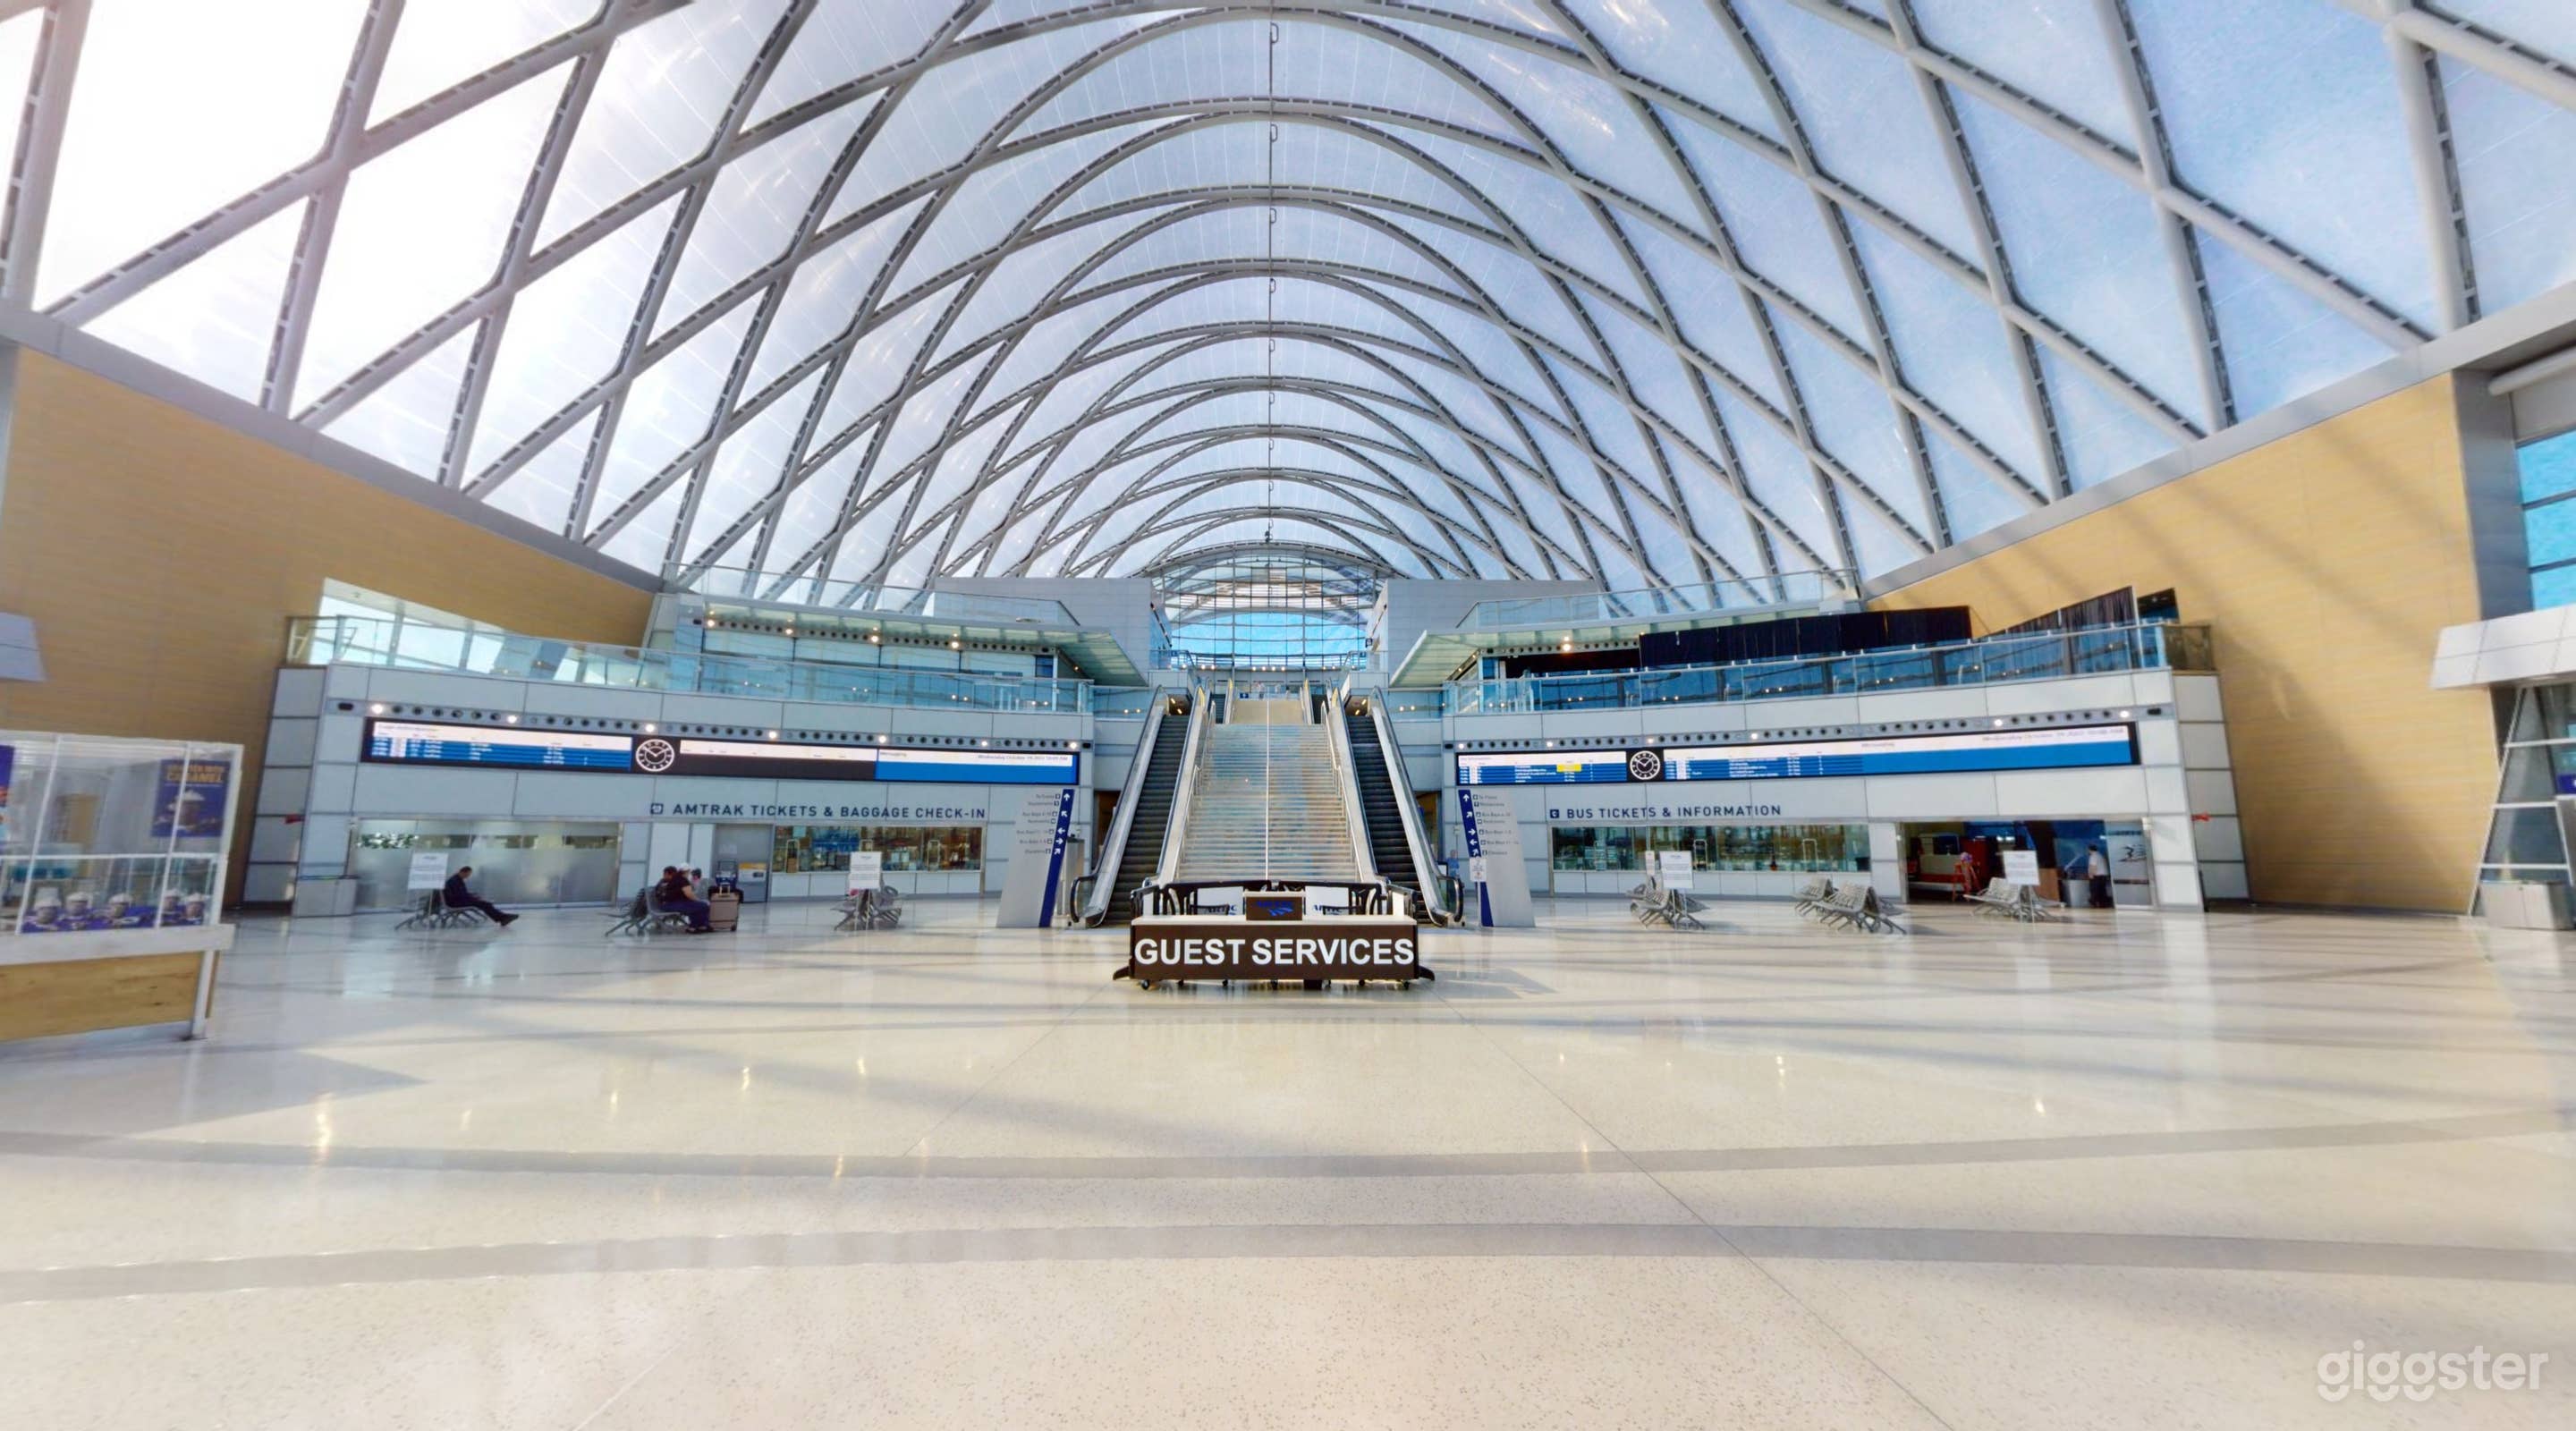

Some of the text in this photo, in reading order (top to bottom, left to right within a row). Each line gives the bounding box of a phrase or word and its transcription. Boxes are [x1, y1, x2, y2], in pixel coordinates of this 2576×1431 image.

[672, 803, 986, 819] AMTRAK TICKETS & BAGGAGE CHECK-IN
[1567, 805, 1782, 819] BUS TICKETS & INFORMATION
[1134, 938, 1415, 965] GUEST SERVICES
